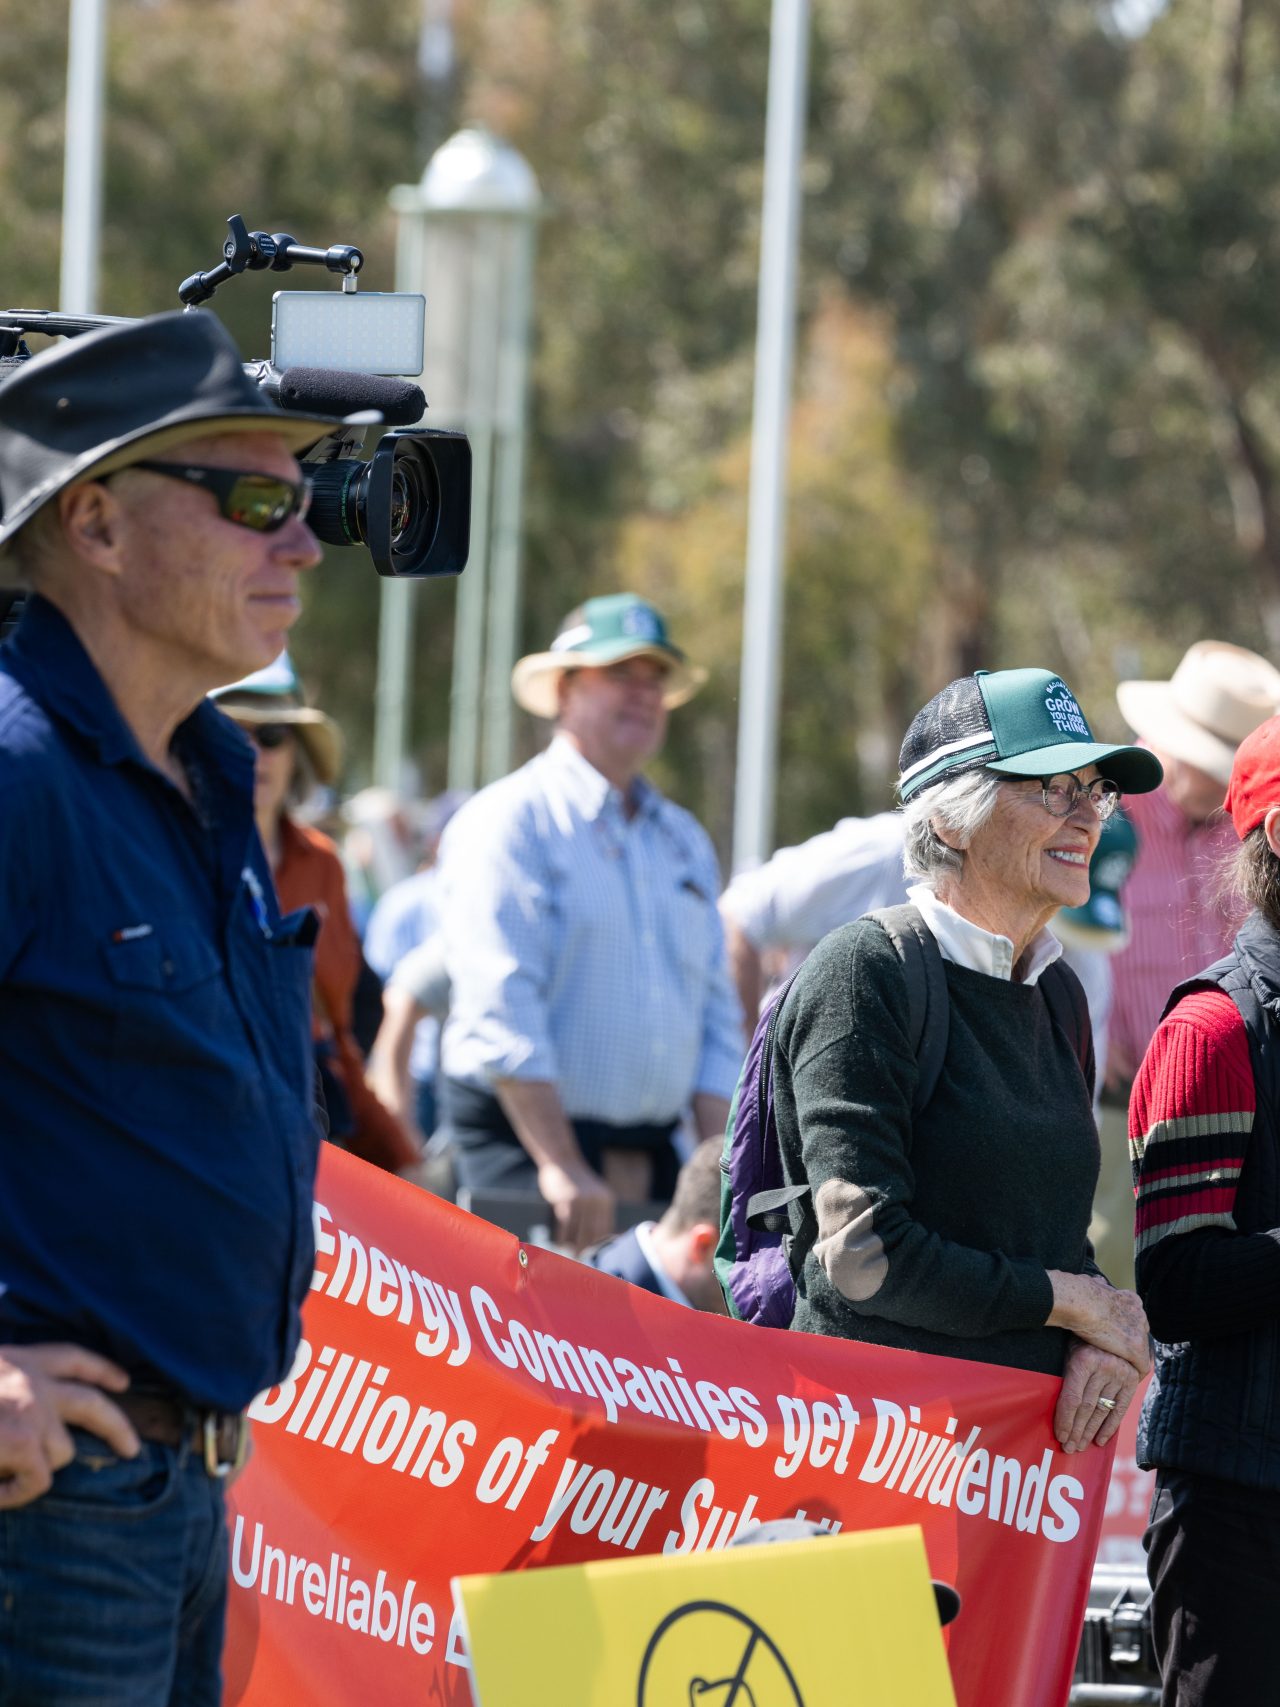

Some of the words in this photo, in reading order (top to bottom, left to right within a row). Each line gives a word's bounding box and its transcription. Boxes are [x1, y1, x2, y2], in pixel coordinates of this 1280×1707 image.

[1045, 698, 1080, 715] GROW
[1050, 712, 1067, 721] YOU
[1052, 720, 1089, 736] THING
[309, 1201, 471, 1367] Energy
[470, 1286, 768, 1447] Companies
[774, 1393, 860, 1478] get
[858, 1397, 1084, 1543] Dividends
[247, 1339, 477, 1487] Billions
[476, 1429, 560, 1511] of
[530, 1457, 669, 1551] your
[231, 1514, 435, 1655] Unreliable
